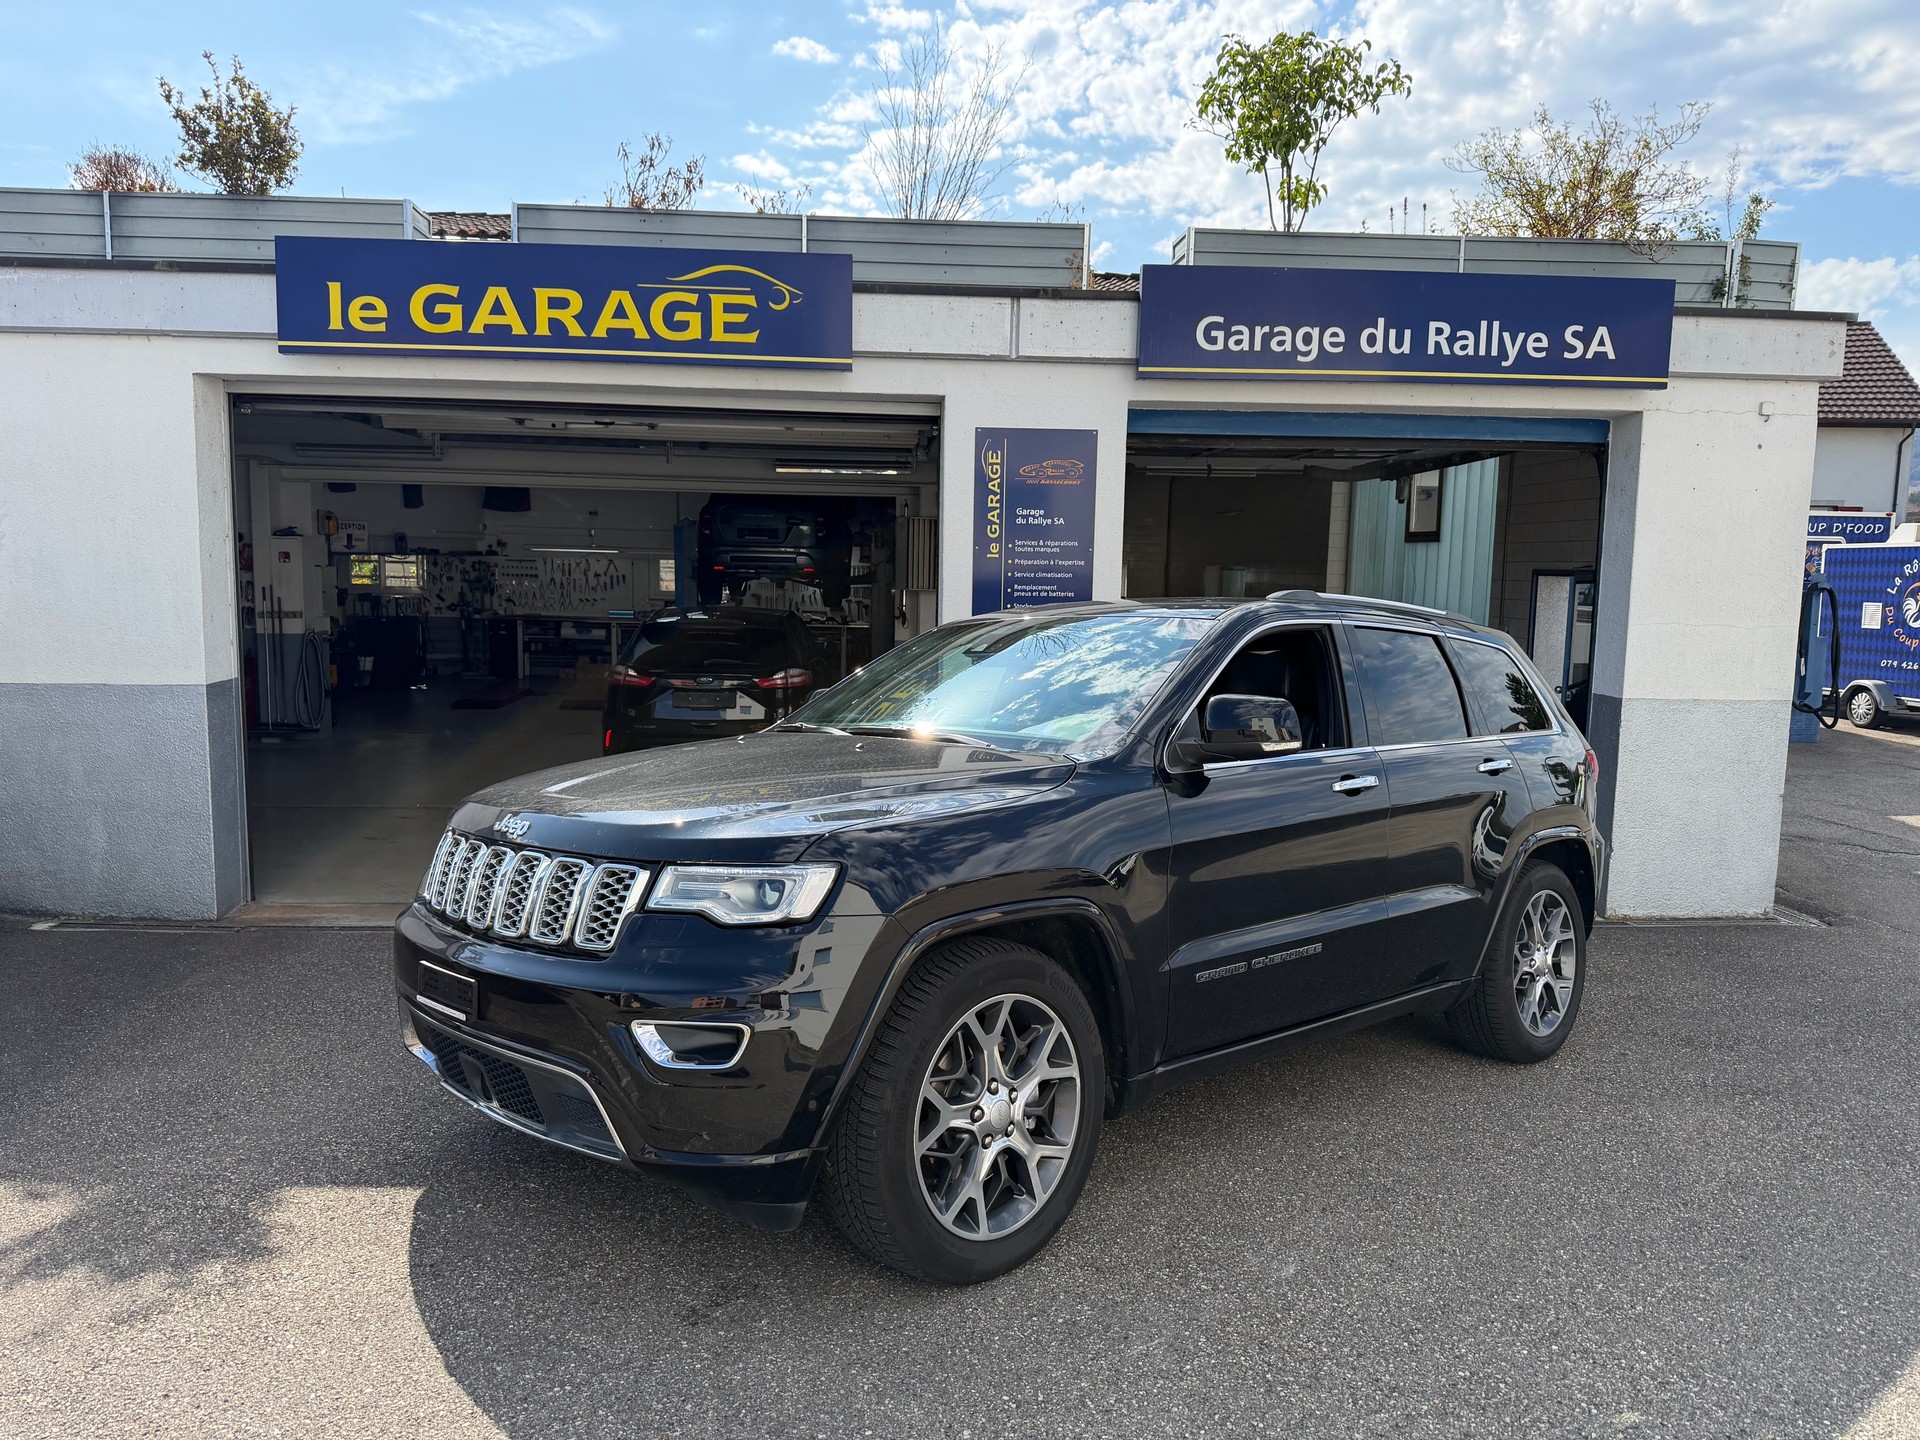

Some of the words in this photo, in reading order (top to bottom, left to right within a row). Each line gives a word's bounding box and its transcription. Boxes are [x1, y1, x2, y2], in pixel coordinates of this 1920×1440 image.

[326, 281, 387, 333] le
[409, 283, 760, 343] GARAGE
[1195, 315, 1346, 362] Garage
[1359, 317, 1411, 355] du
[1427, 320, 1549, 367] Rallye
[1563, 325, 1617, 360] SA
[986, 450, 1001, 538] GARAGE
[1015, 516, 1027, 525] du
[1028, 517, 1052, 526] Rallye
[1053, 517, 1065, 525] SA
[1016, 507, 1045, 517] Garage
[337, 522, 366, 531] CEPTION
[1808, 522, 1827, 533] UP
[1832, 522, 1884, 534] D'FOOD
[986, 542, 1000, 558] le
[1014, 558, 1049, 566] Préparation
[1903, 558, 1920, 577] Rô
[1885, 606, 1894, 626] Du
[1893, 628, 1920, 651] Coup
[1880, 659, 1898, 668] 079
[1901, 660, 1919, 670] 426
[493, 813, 531, 839] Jeep
[1196, 961, 1249, 983] GRAND
[1251, 942, 1323, 969] CHEROKEE
[1049, 971, 1097, 1036] Continental
